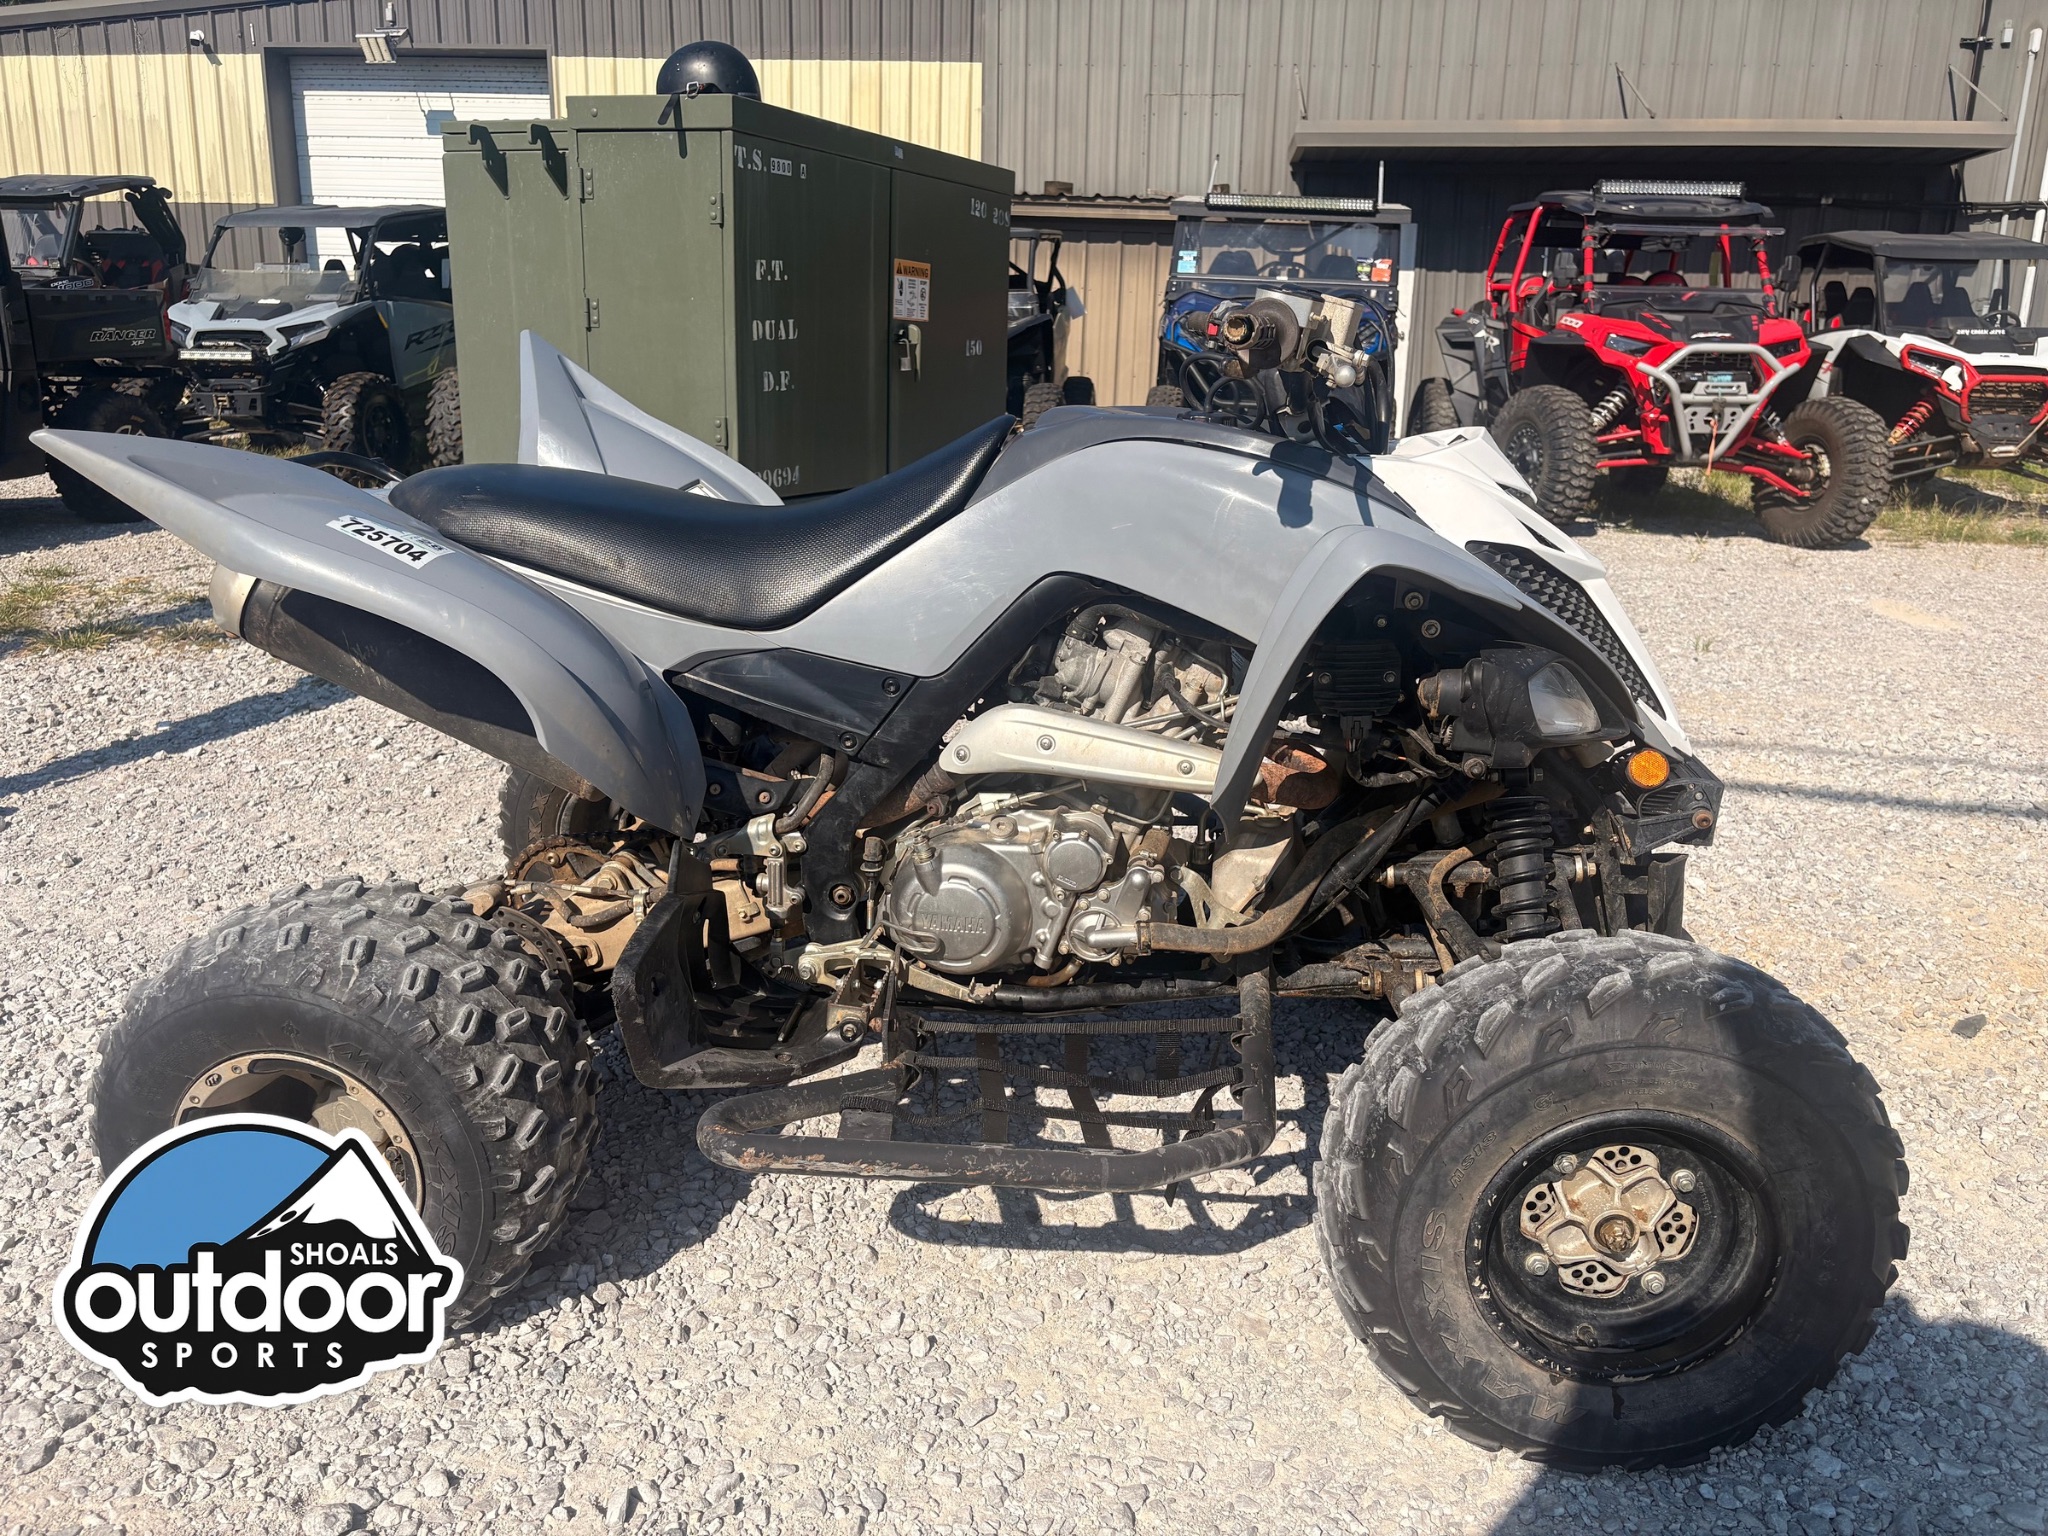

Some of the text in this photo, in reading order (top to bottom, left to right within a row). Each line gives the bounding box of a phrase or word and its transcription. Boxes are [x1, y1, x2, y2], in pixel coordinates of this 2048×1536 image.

[734, 144, 768, 172] T.S.
[755, 259, 788, 281] F.T.
[89, 328, 156, 343] RANGER
[752, 319, 798, 341] DUAL
[763, 370, 795, 392] D.F.
[755, 465, 800, 488] 9694
[340, 519, 428, 562] 725704
[921, 912, 987, 934] YAMAHA
[1420, 1208, 1591, 1426] MAXXIS
